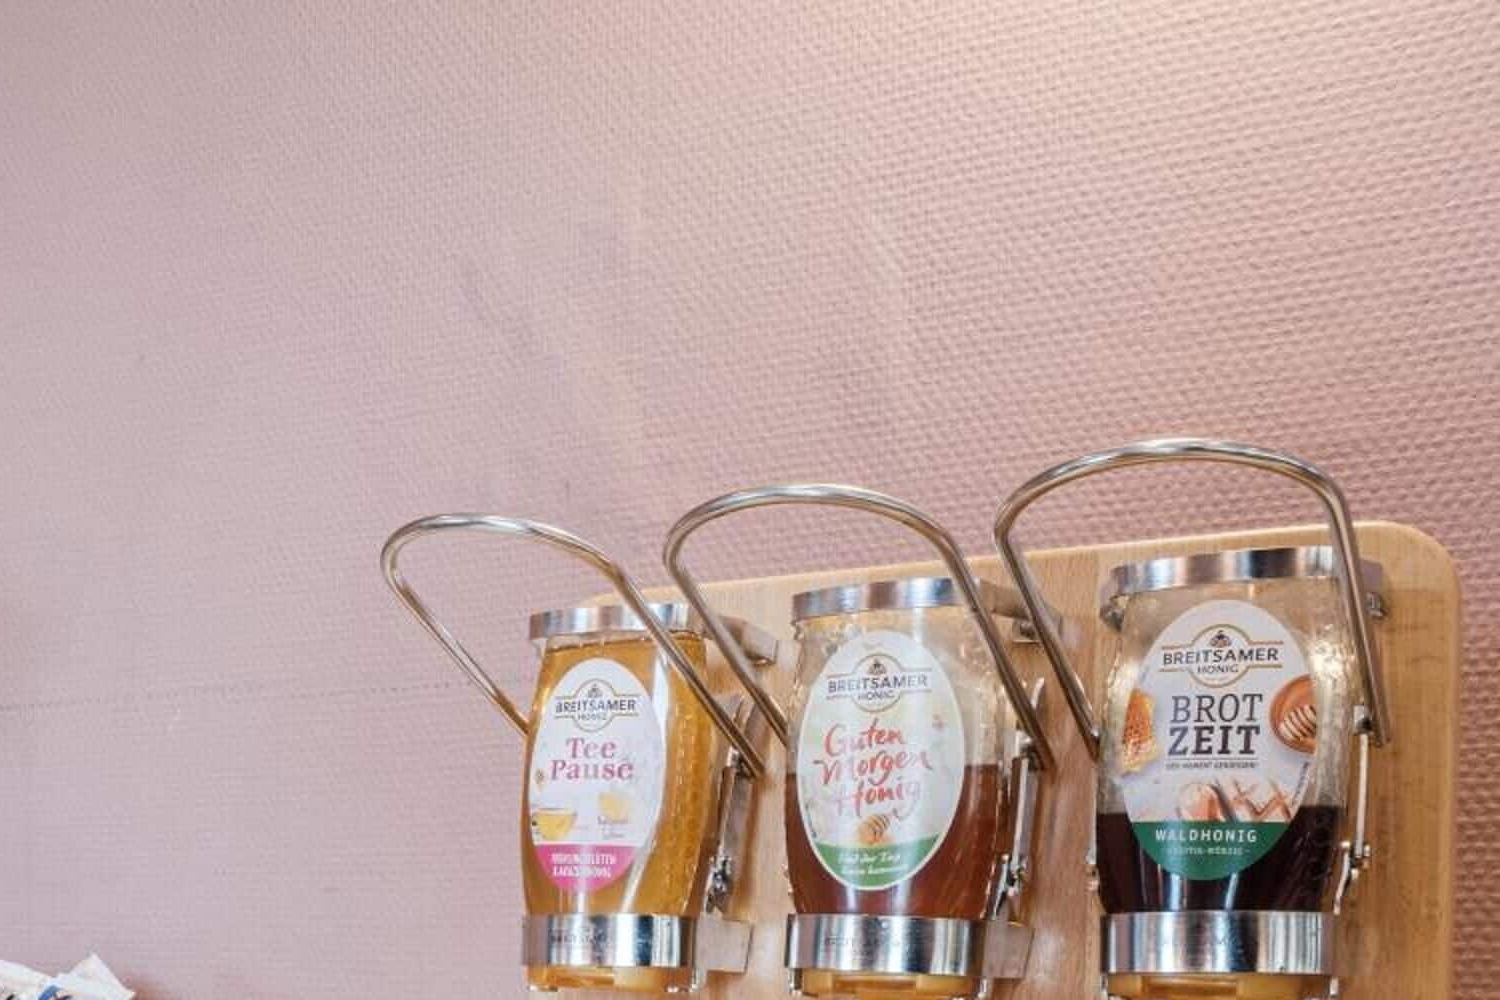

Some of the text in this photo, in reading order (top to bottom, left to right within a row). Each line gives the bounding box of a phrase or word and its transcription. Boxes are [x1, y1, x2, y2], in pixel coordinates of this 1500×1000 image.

[1161, 646, 1279, 667] BREITSAMER
[1197, 663, 1239, 676] HONIG
[827, 674, 928, 694] BREITSAMER
[555, 699, 637, 714] BREITSAMER
[1169, 693, 1263, 724] BROT
[565, 736, 617, 759] Tee
[1167, 725, 1261, 757] ZEIT
[550, 759, 635, 781] Pause
[1155, 829, 1258, 844] WALDHONIG
